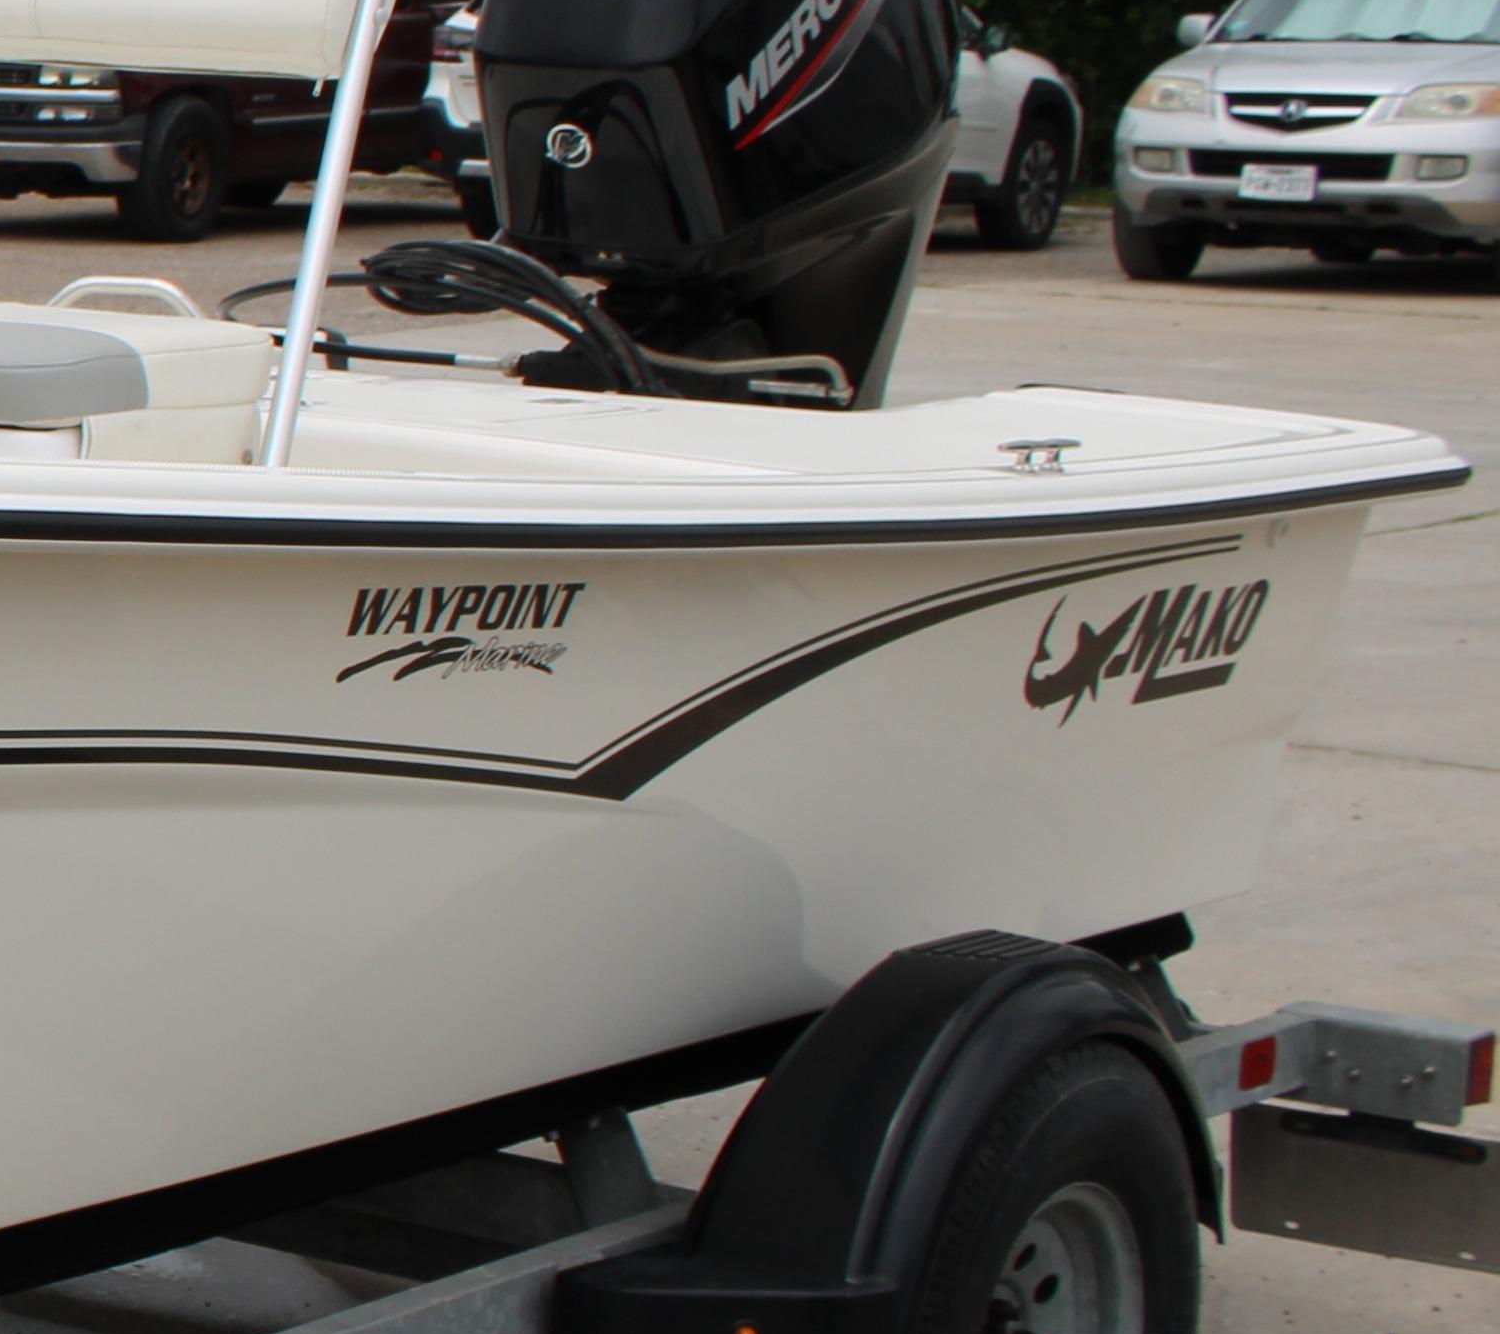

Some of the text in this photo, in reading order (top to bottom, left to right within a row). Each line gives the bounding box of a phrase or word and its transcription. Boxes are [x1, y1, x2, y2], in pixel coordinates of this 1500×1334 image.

[346, 582, 587, 637] WAYPOINT
[441, 636, 568, 680] Marine
[1103, 578, 1270, 705] MAKO
